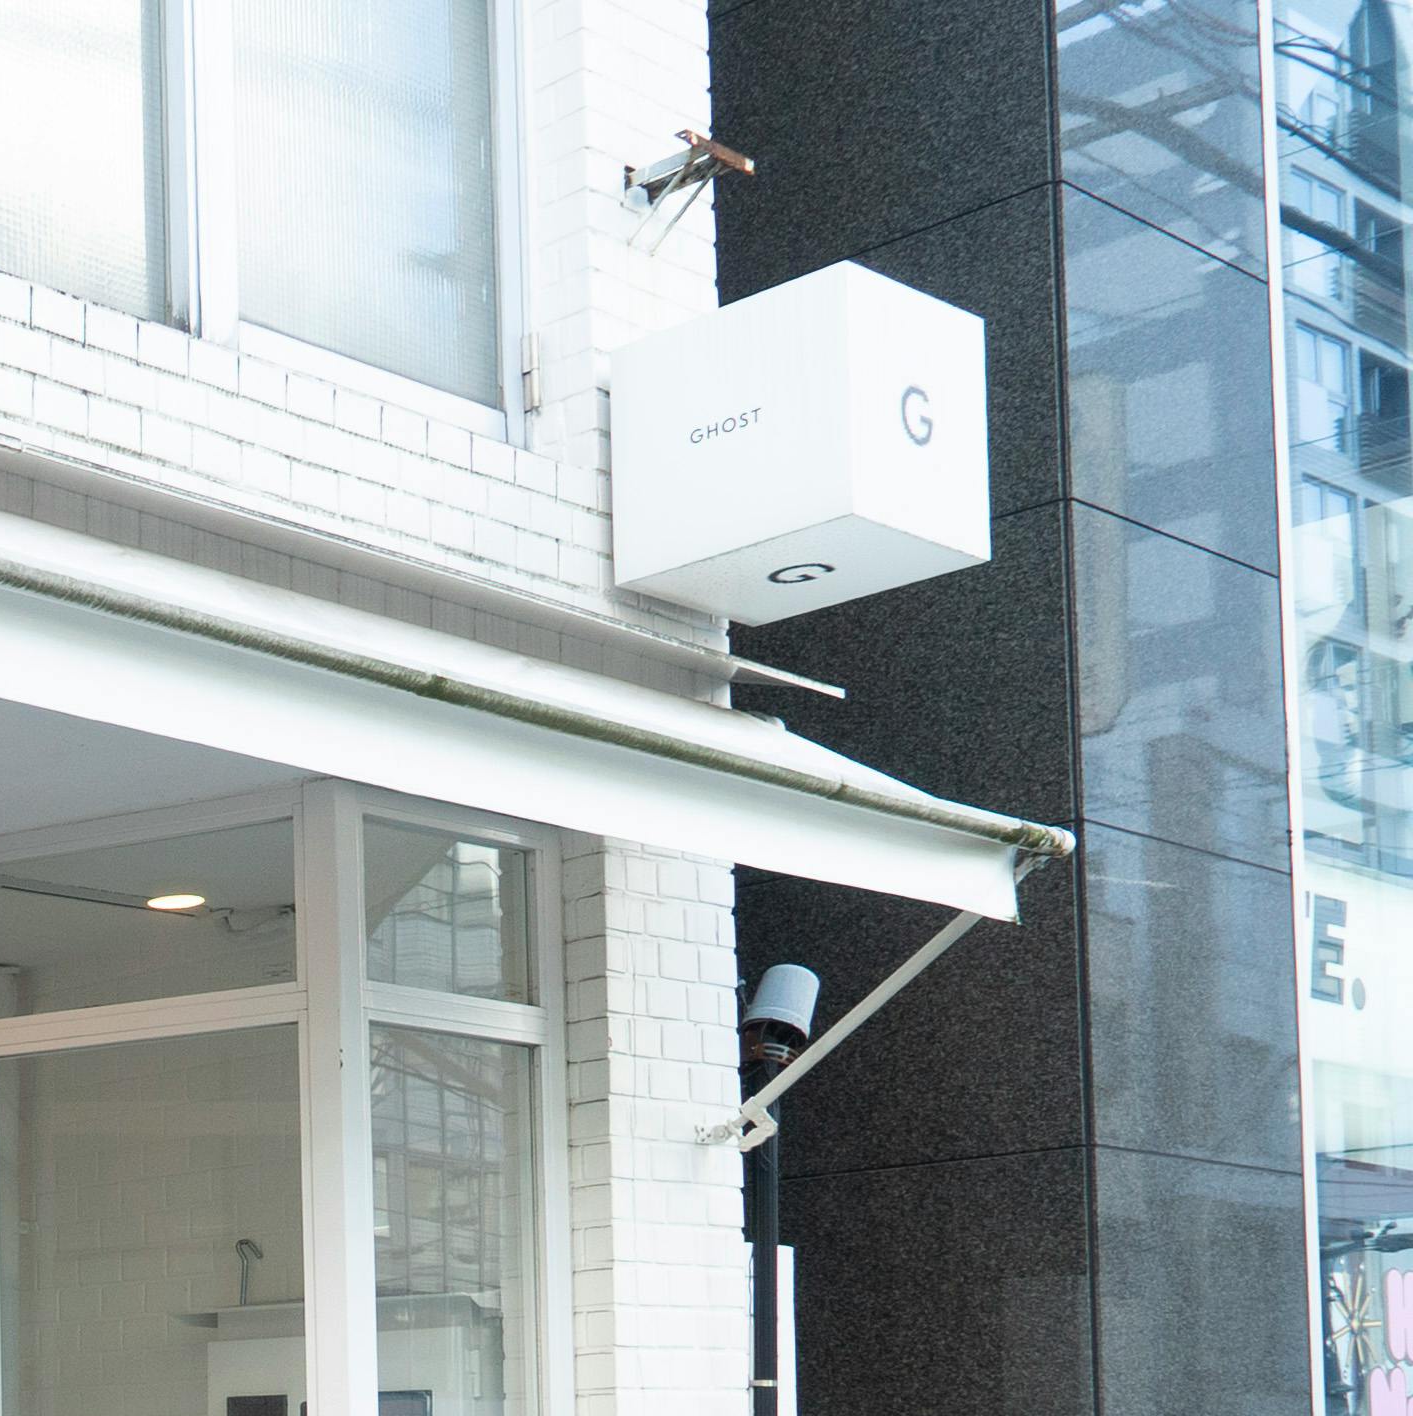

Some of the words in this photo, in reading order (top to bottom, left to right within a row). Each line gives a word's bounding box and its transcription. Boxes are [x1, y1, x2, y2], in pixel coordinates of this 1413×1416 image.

[690, 407, 762, 445] GHOST
[900, 384, 933, 447] G
[767, 562, 836, 585] G
